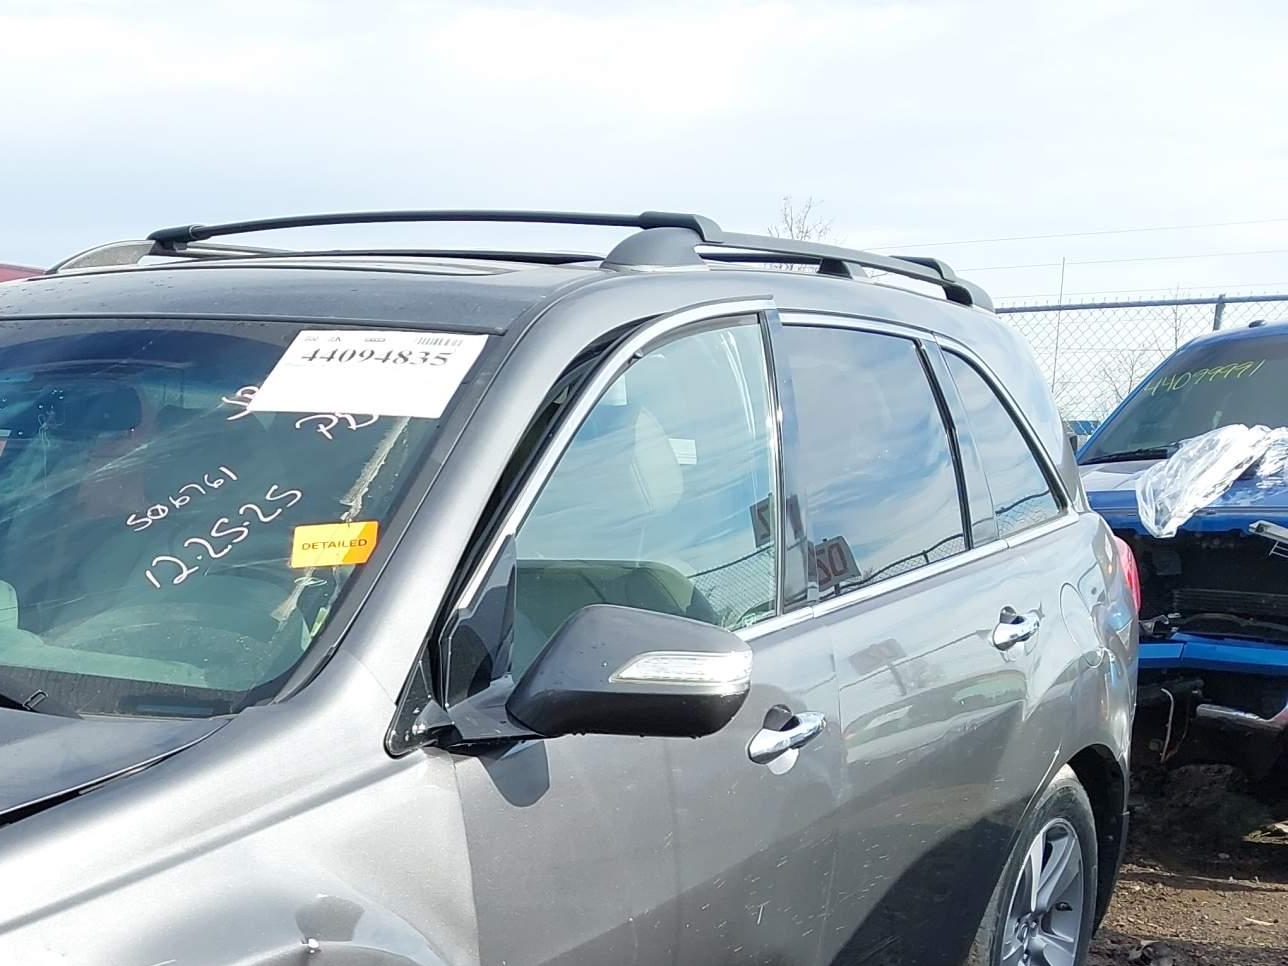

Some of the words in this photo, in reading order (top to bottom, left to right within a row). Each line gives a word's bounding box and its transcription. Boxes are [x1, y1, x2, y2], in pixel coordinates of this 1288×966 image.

[301, 348, 453, 367] 44094835
[145, 484, 302, 588] 12.25.25
[301, 538, 368, 550] DETAILED
